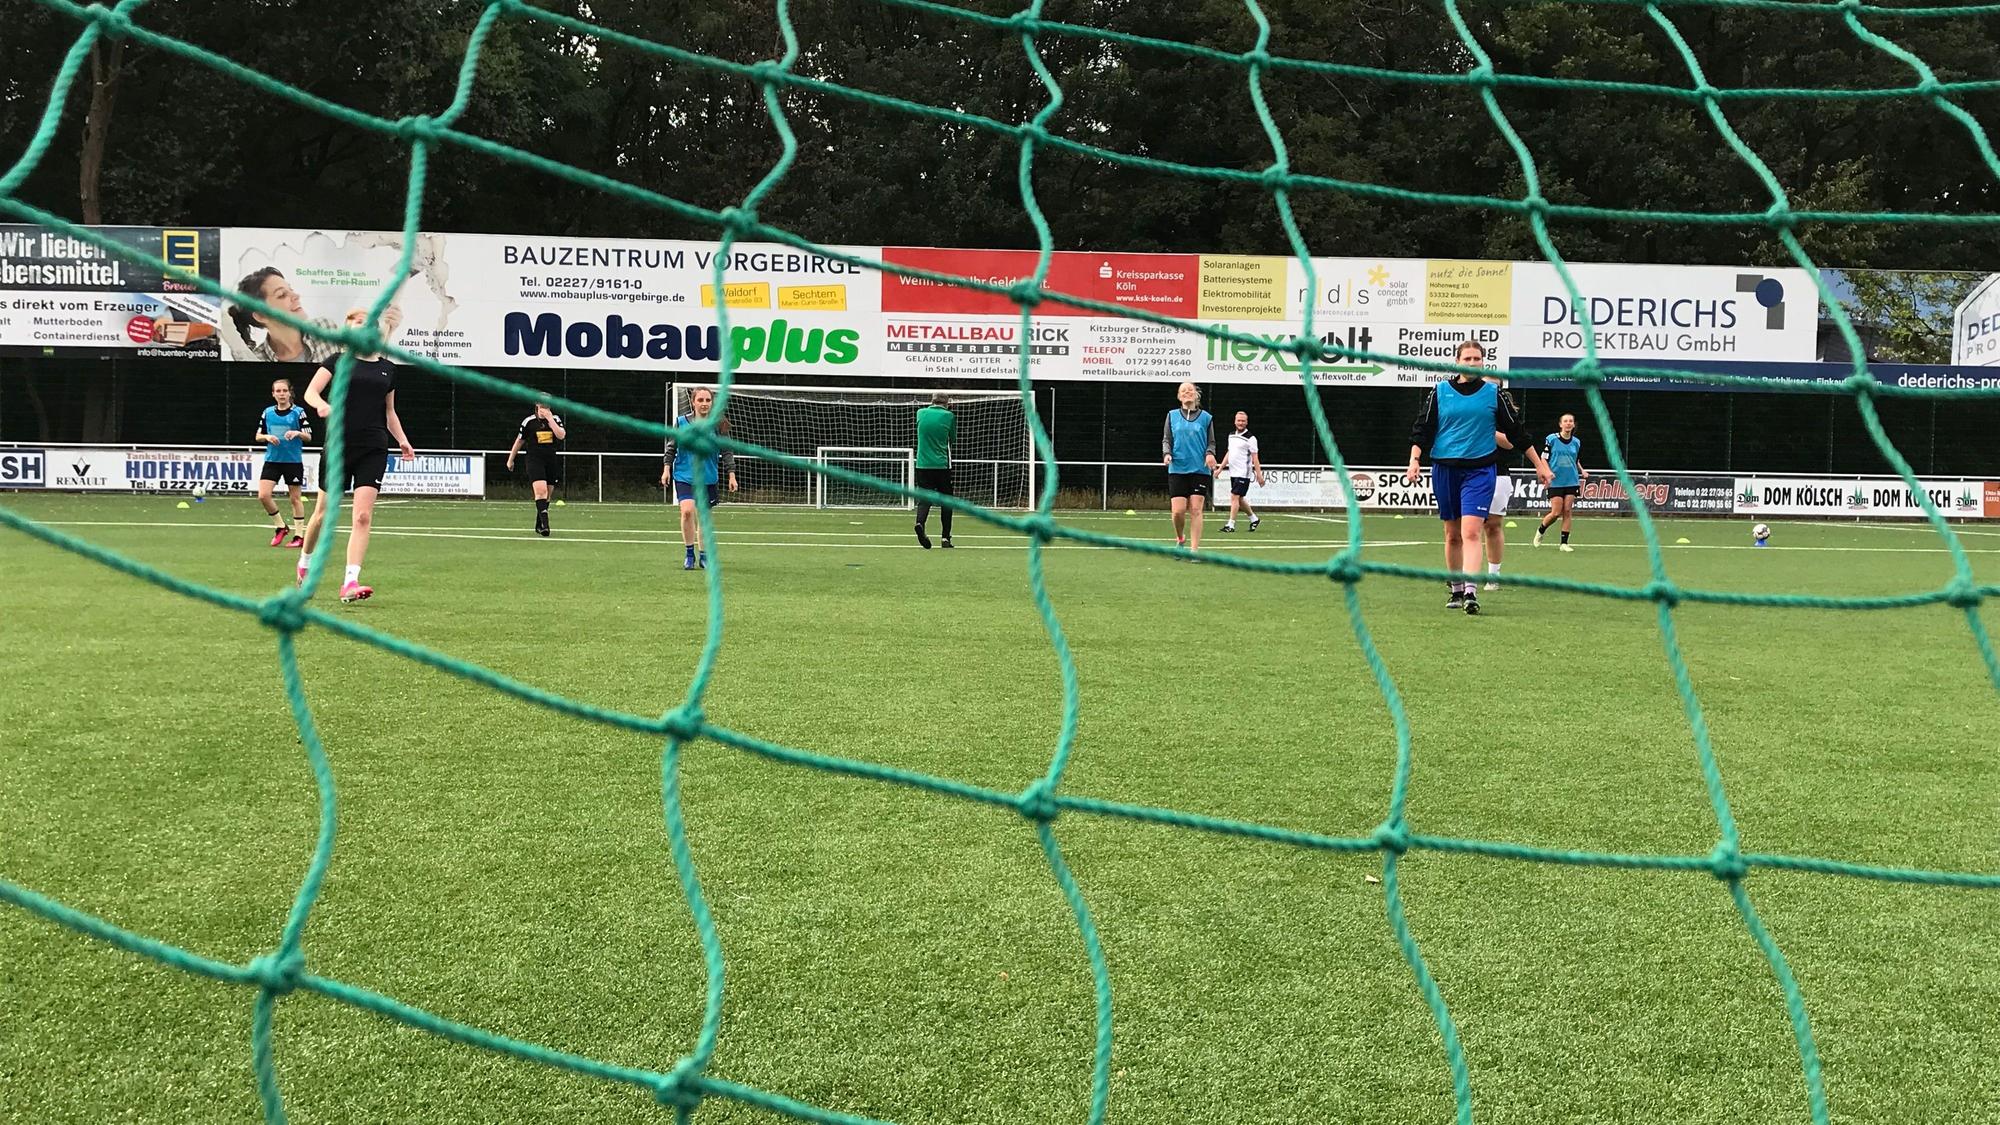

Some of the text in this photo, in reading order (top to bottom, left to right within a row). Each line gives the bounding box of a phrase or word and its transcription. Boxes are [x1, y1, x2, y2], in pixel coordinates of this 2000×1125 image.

[503, 245, 861, 275] BAUZENTRUM VORGEBIRGE
[1203, 260, 1261, 270] Solaranlagen
[295, 268, 334, 276] Schaffen
[1116, 269, 1184, 281] Kreissparkasse
[1458, 266, 1473, 278] die
[1476, 264, 1509, 278] Sonne!
[520, 276, 643, 290] Tel. 02227/9161-0
[1203, 275, 1273, 285] Batteriesysteme
[1389, 280, 1409, 289] solar
[1116, 280, 1137, 291] Köln
[520, 290, 685, 303] www.mobauplus-vorgebirge.de
[792, 289, 837, 300] Sechtem
[1202, 289, 1272, 299] Elektromobilität
[1377, 289, 1409, 297] concept
[1116, 294, 1184, 304] www.ksk-koeln.de
[12, 299, 55, 310] direkt
[60, 302, 88, 311] vom
[94, 300, 159, 314] Erzeuger
[1202, 304, 1282, 315] Investorenprojekte
[1543, 296, 1736, 328] DEDERICHS
[33, 316, 103, 326] Mutterboden
[407, 328, 465, 338] Alles andere
[887, 324, 1014, 341] METALLBAU
[1090, 325, 1139, 334] Kitzburger
[1142, 325, 1172, 334] Straße
[1398, 327, 1499, 342] Premium LED
[33, 331, 121, 341] Containerdienst
[503, 311, 861, 369] Mobauplus
[1130, 336, 1176, 344] Bornheim
[398, 339, 472, 348] dazu bekommen
[1677, 333, 1736, 352] GmbH
[409, 349, 423, 358] Sie
[426, 350, 439, 358] bei
[890, 342, 1067, 355] MEISTERBETIEB
[1083, 346, 1125, 354] TELEFON
[905, 354, 954, 363] GELÄNDER
[969, 356, 1001, 364] GITTER
[1083, 357, 1113, 365] MOBIL
[1151, 358, 1191, 366] 9914640
[925, 365, 934, 373] in
[936, 365, 959, 374] Stahl
[961, 366, 978, 374] und
[1082, 368, 1191, 377] metallbaurick@aol.com
[1207, 363, 1277, 372] GmbH & Co. KG
[1397, 374, 1418, 382] Mail
[393, 456, 467, 473] ZIMMERMANN
[125, 460, 253, 481] HOFFMANN
[56, 477, 108, 486] RENAULT
[1281, 470, 1322, 484] ROLEFF
[1378, 474, 1433, 488] SPORT
[1675, 487, 1695, 497] Telefon
[1700, 488, 1708, 497] 22
[1764, 485, 1843, 507] DOM KÖLSCH
[1377, 490, 1438, 506] KRÄME
[1737, 493, 1760, 503] Dom
[1846, 495, 1869, 505] Dom
[1873, 489, 1901, 508] DOM
[1954, 496, 1978, 507] Dom
